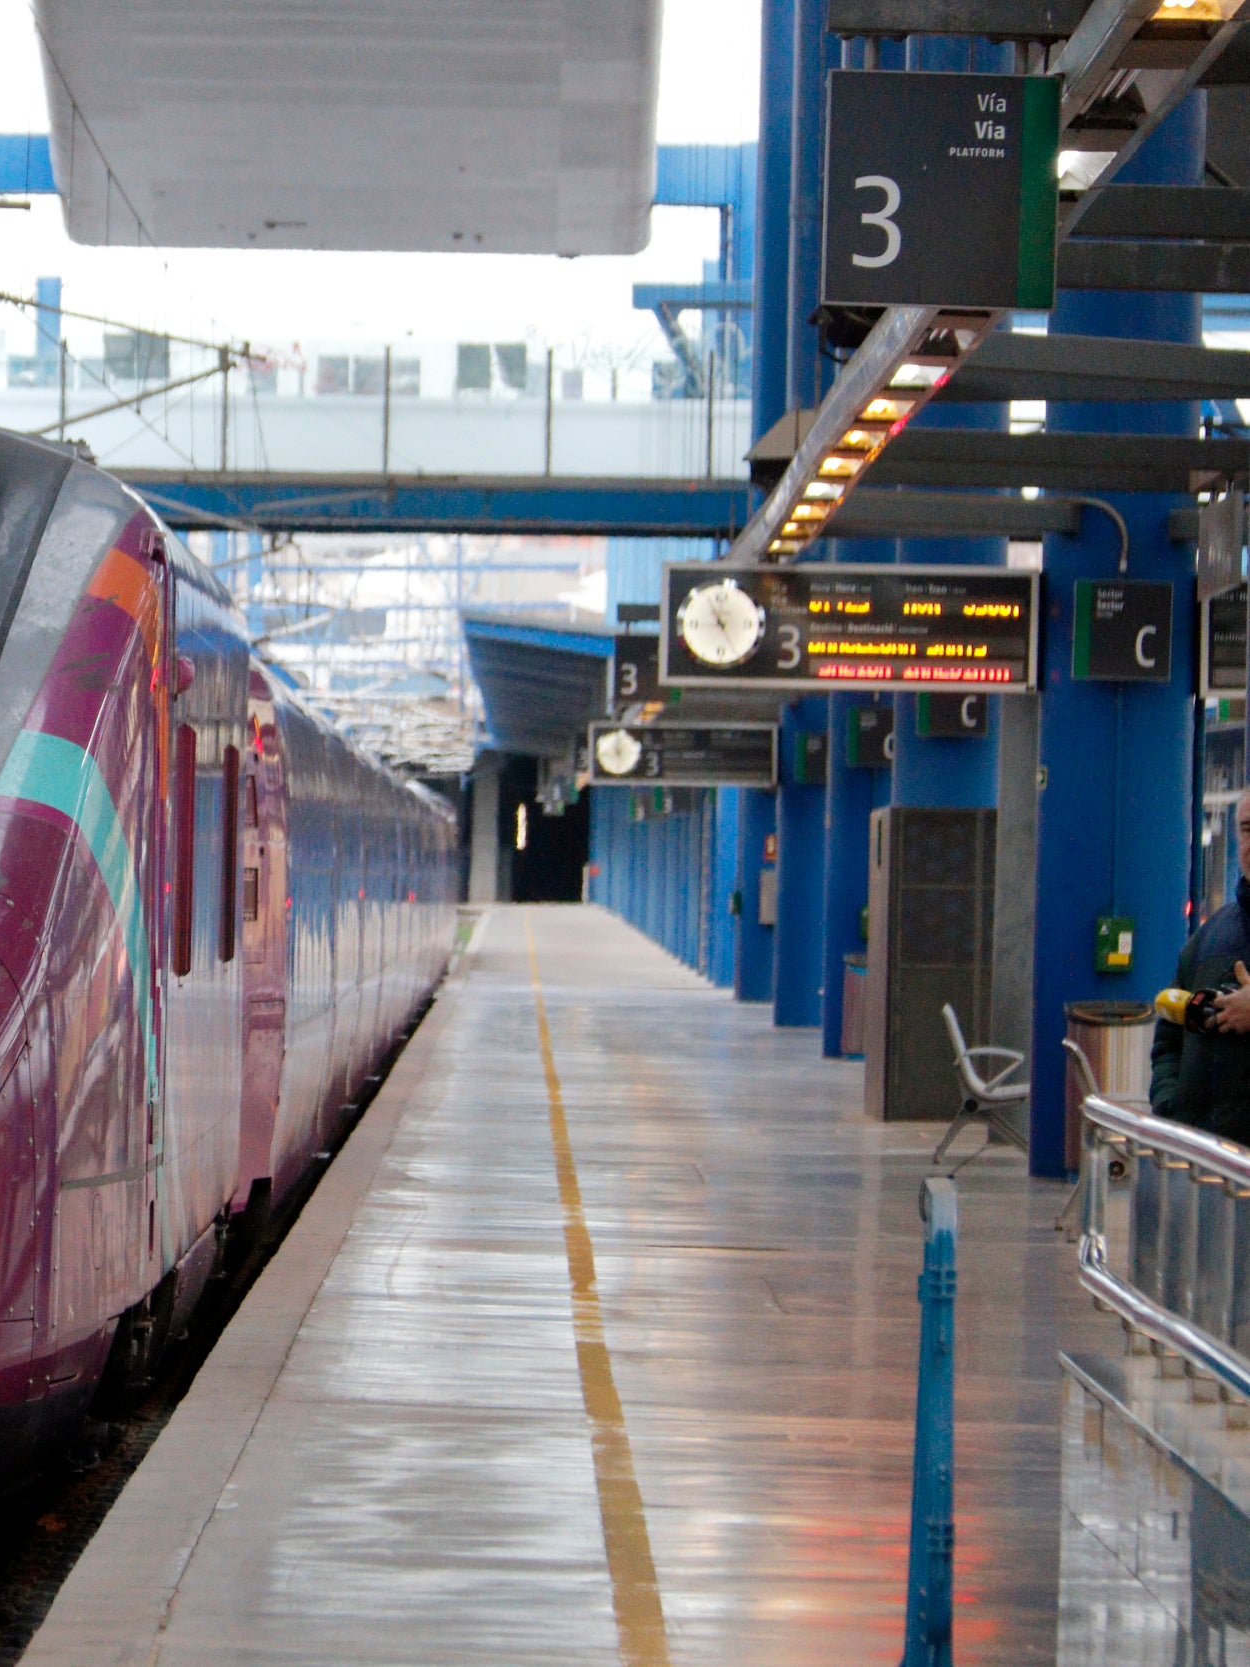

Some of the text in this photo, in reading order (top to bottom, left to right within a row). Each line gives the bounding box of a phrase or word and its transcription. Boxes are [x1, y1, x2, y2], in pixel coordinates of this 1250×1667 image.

[977, 92, 1007, 113] Vía
[975, 121, 1006, 140] Via
[949, 147, 1005, 159] PLATFORM
[852, 174, 902, 268] 3
[777, 625, 802, 670] 3
[1135, 624, 1157, 668] C
[620, 662, 638, 695] 3
[961, 695, 978, 728] C
[645, 751, 660, 776] 3
